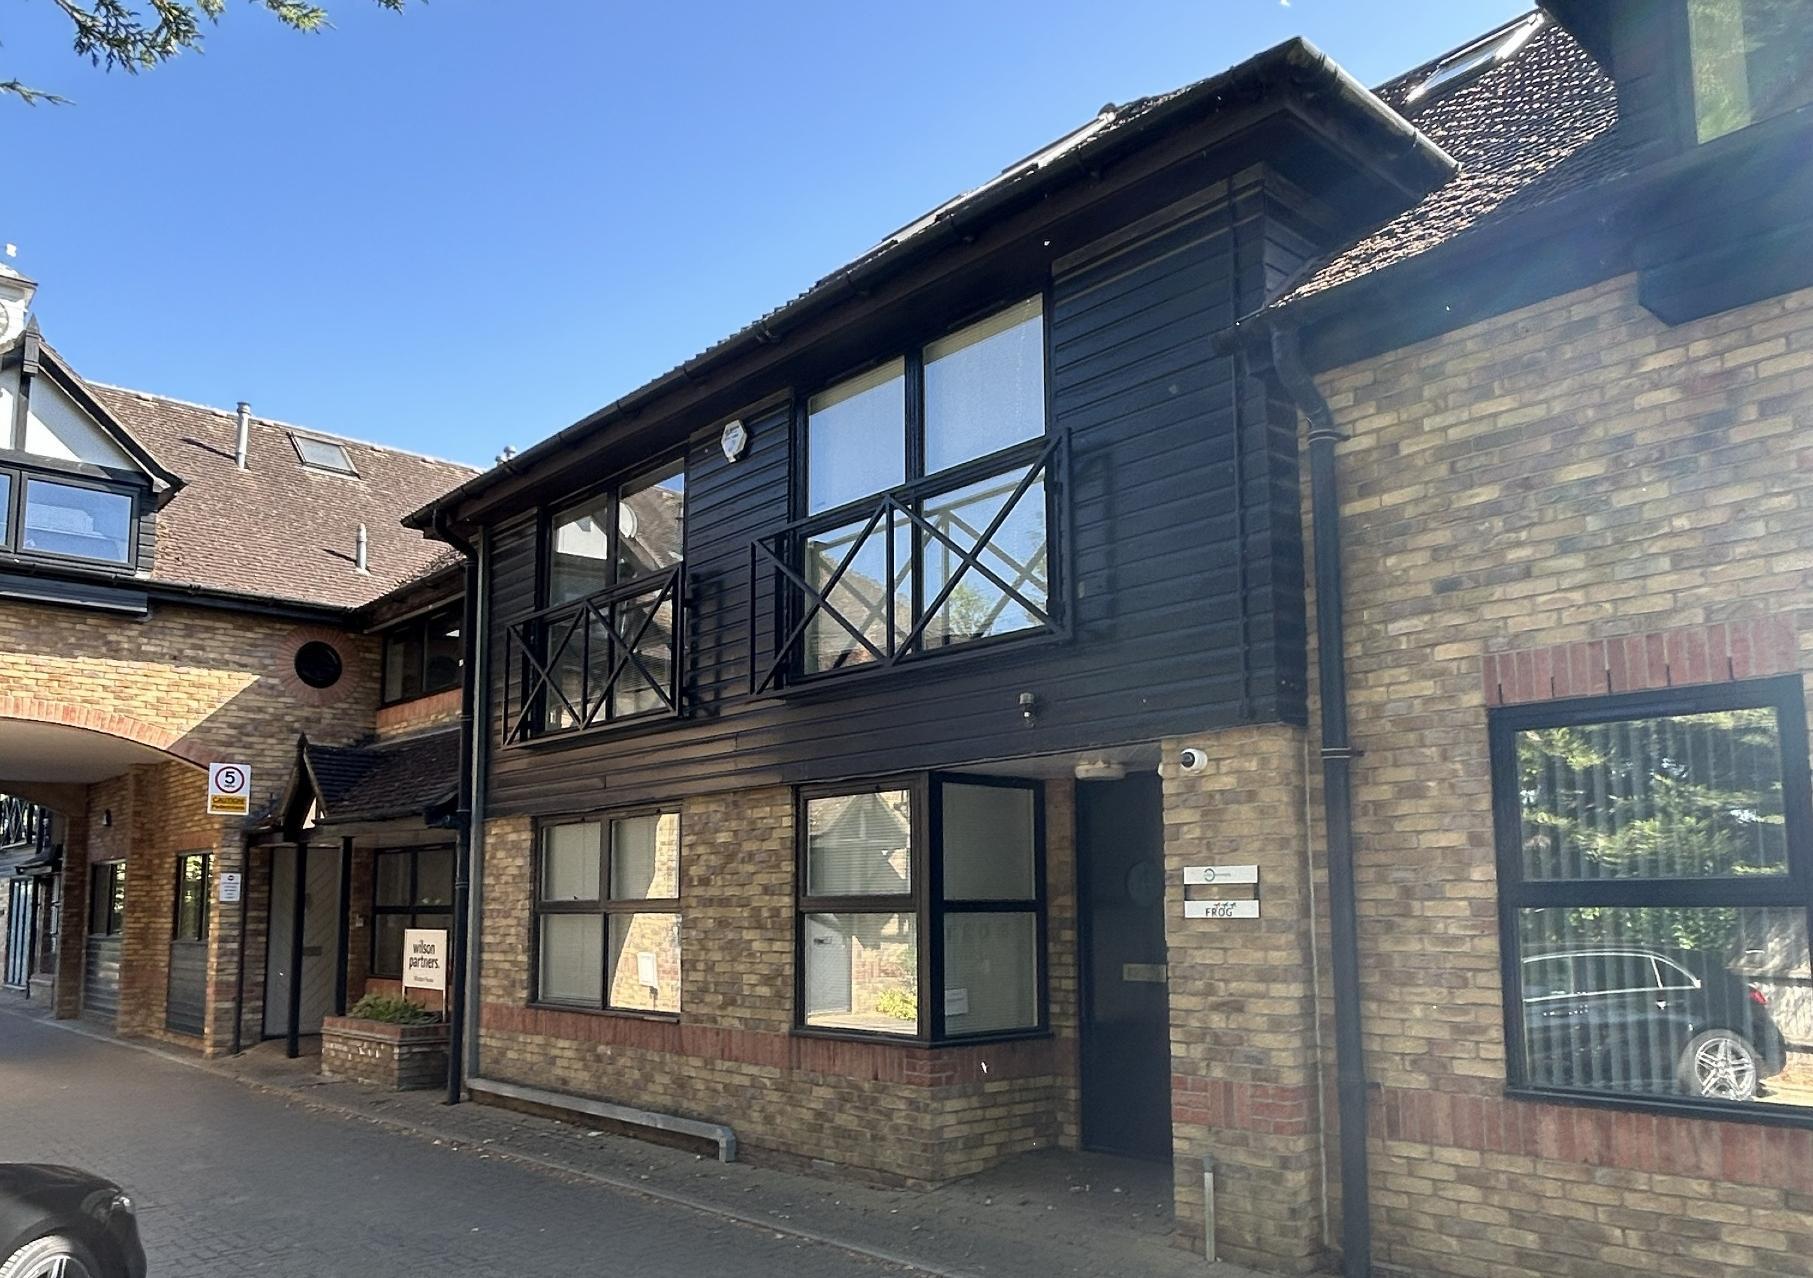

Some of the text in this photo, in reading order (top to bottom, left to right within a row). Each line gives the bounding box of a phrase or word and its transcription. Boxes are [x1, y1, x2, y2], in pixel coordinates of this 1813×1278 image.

[224, 771, 235, 784] 5
[1205, 907, 1233, 917] FROG
[413, 940, 435, 954] wilson
